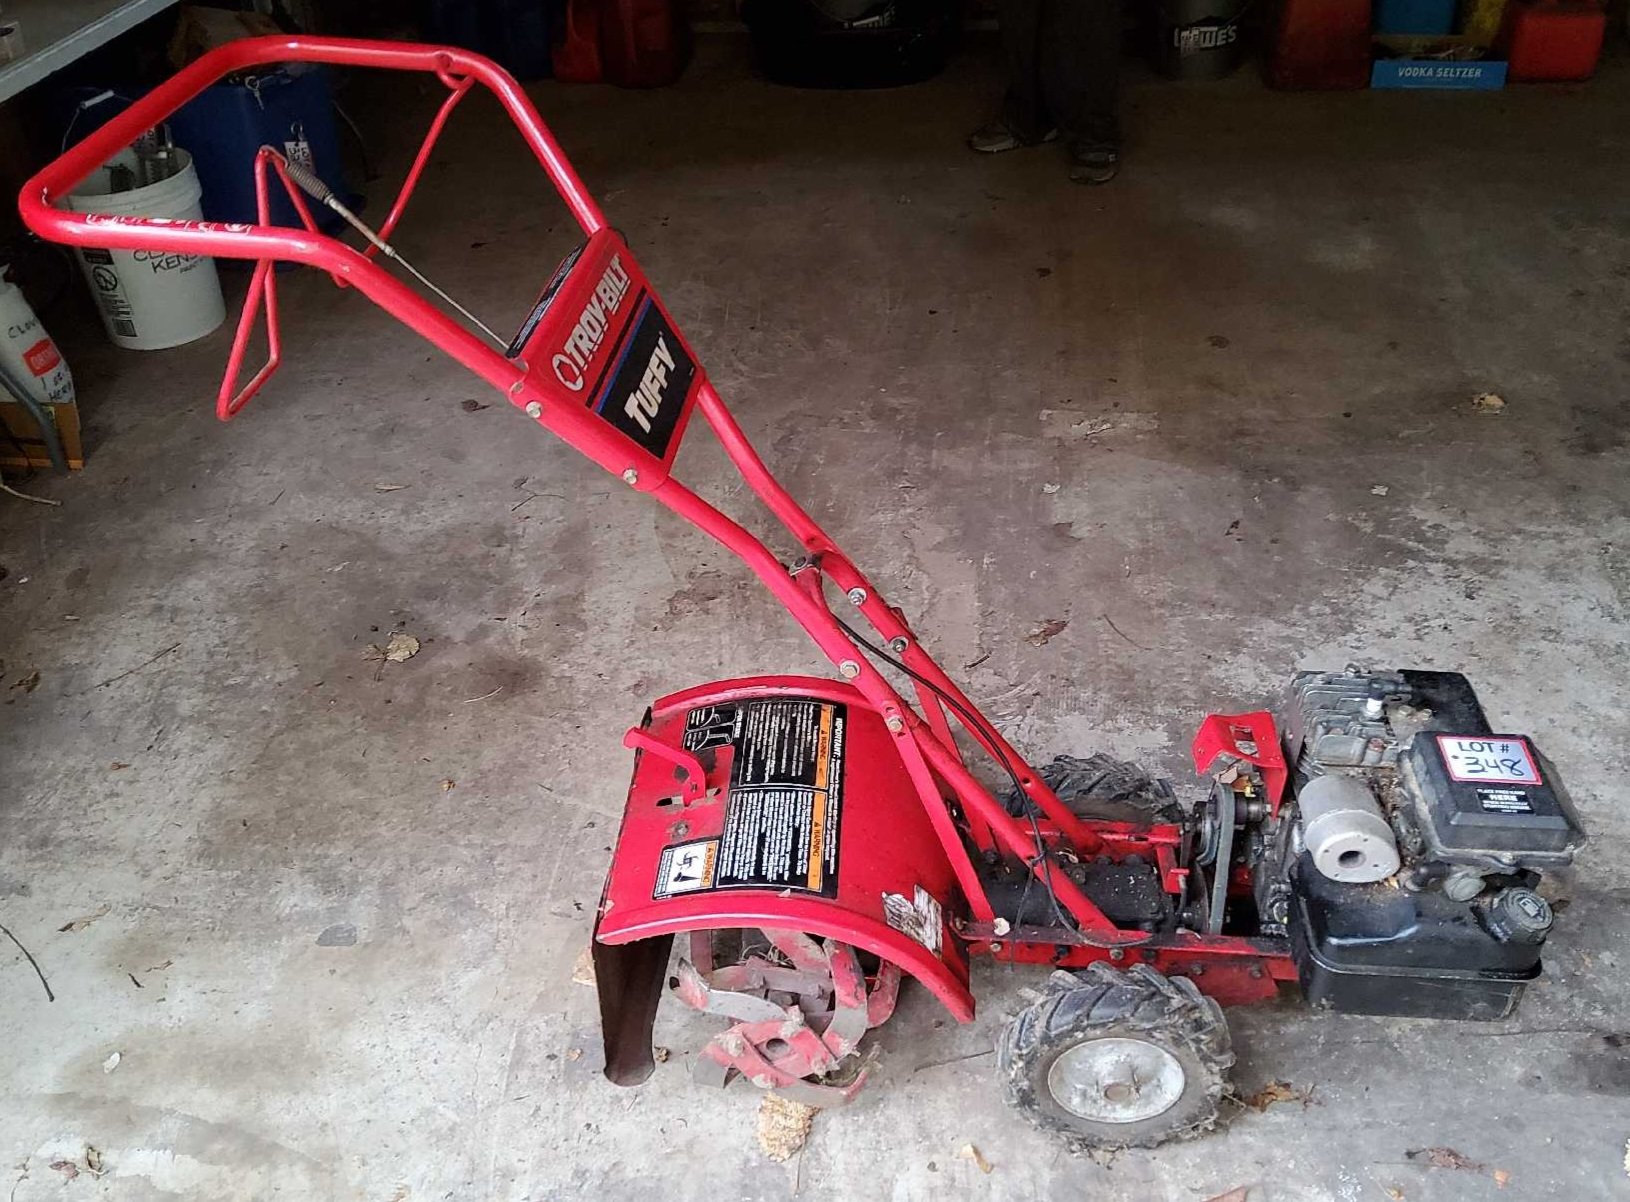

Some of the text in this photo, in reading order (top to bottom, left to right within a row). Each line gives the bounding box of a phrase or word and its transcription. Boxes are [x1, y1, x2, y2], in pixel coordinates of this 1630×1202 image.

[1173, 24, 1238, 48] LWE'S
[1398, 66, 1482, 78] VODKA SELTZER
[563, 253, 631, 371] TROY-BILT
[623, 337, 675, 434] TUFFY
[1458, 741, 1510, 753] LOT #
[1464, 756, 1524, 777] 348
[812, 829, 821, 857] WARNING
